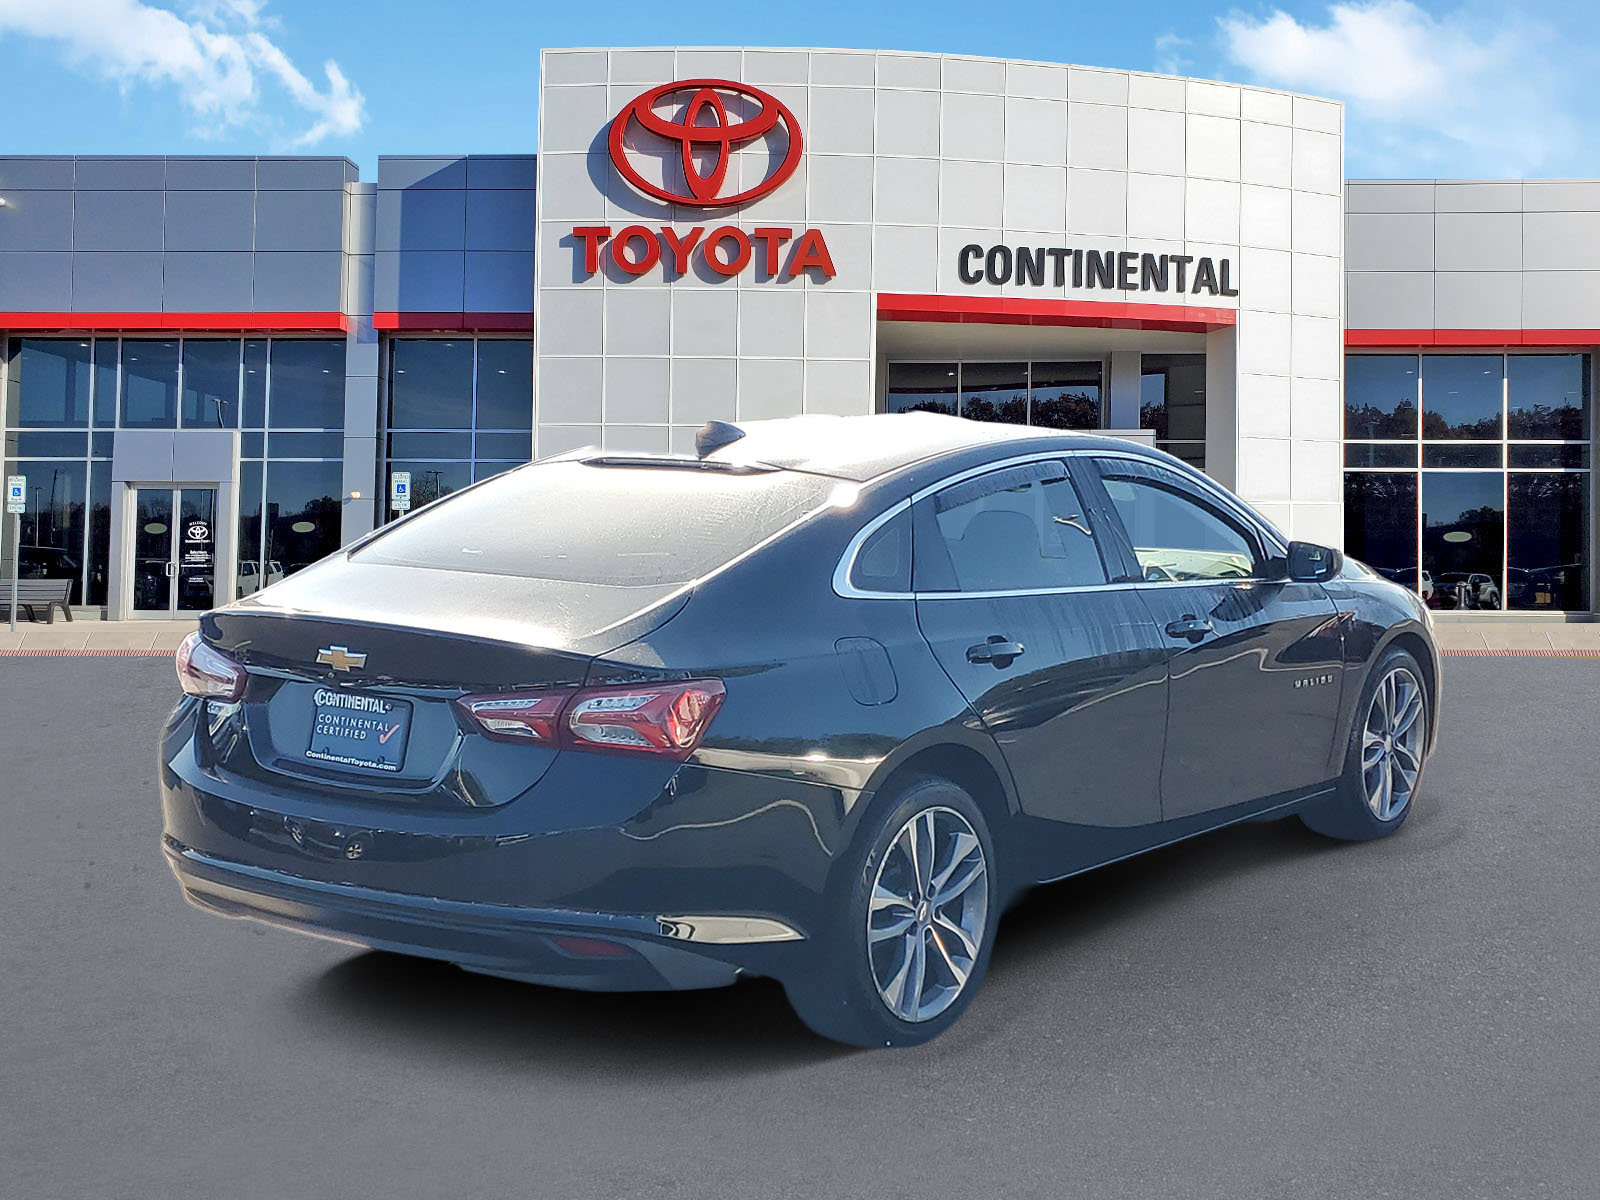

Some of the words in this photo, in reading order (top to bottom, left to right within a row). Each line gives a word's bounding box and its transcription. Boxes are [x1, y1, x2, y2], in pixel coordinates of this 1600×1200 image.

[572, 225, 837, 277] TOYOTA
[958, 243, 1239, 297] CONTINENTAL
[1294, 674, 1333, 688] MALIBU
[313, 688, 386, 714] CONTINENTAL
[316, 724, 367, 740] CERTIFIED
[318, 714, 390, 732] CONTINENTAL
[305, 750, 397, 771] ContinentalToyota.com
